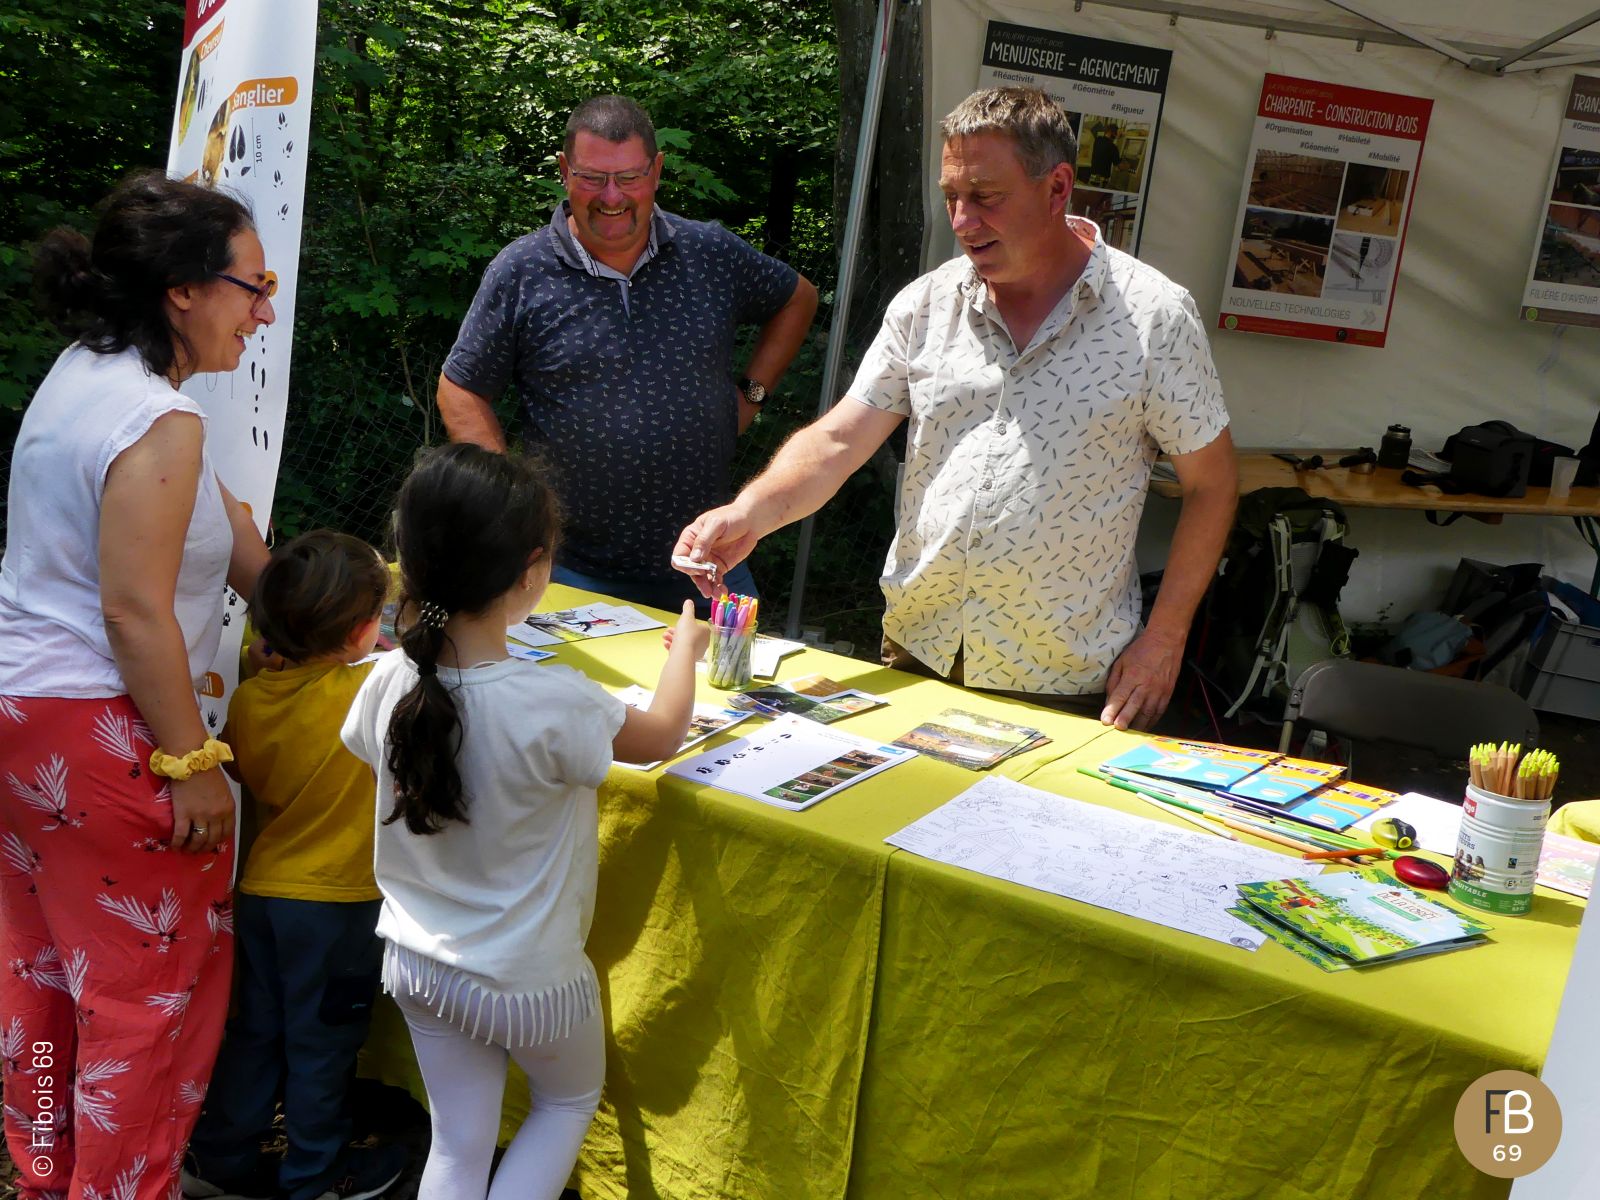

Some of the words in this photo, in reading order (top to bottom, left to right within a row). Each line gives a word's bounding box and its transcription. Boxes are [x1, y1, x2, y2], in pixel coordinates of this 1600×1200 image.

[989, 41, 1066, 72] MENUISERIE
[1079, 57, 1160, 86] AGENCEMENT
[992, 70, 1035, 84] #Réactivité
[1072, 83, 1115, 97] #Géométrie
[1111, 103, 1144, 116] #Rigueur
[1264, 94, 1316, 119] CHARPENTE
[1325, 104, 1396, 131] CONSTRUCTION
[1395, 114, 1419, 134] BOIS
[1265, 122, 1313, 137] #Organisation
[256, 134, 262, 149] cm
[1300, 141, 1340, 154] #Géométrie
[255, 151, 262, 163] 10
[1229, 296, 1282, 312] NOUVELLES
[1284, 303, 1351, 320] TECHNOLOGIES
